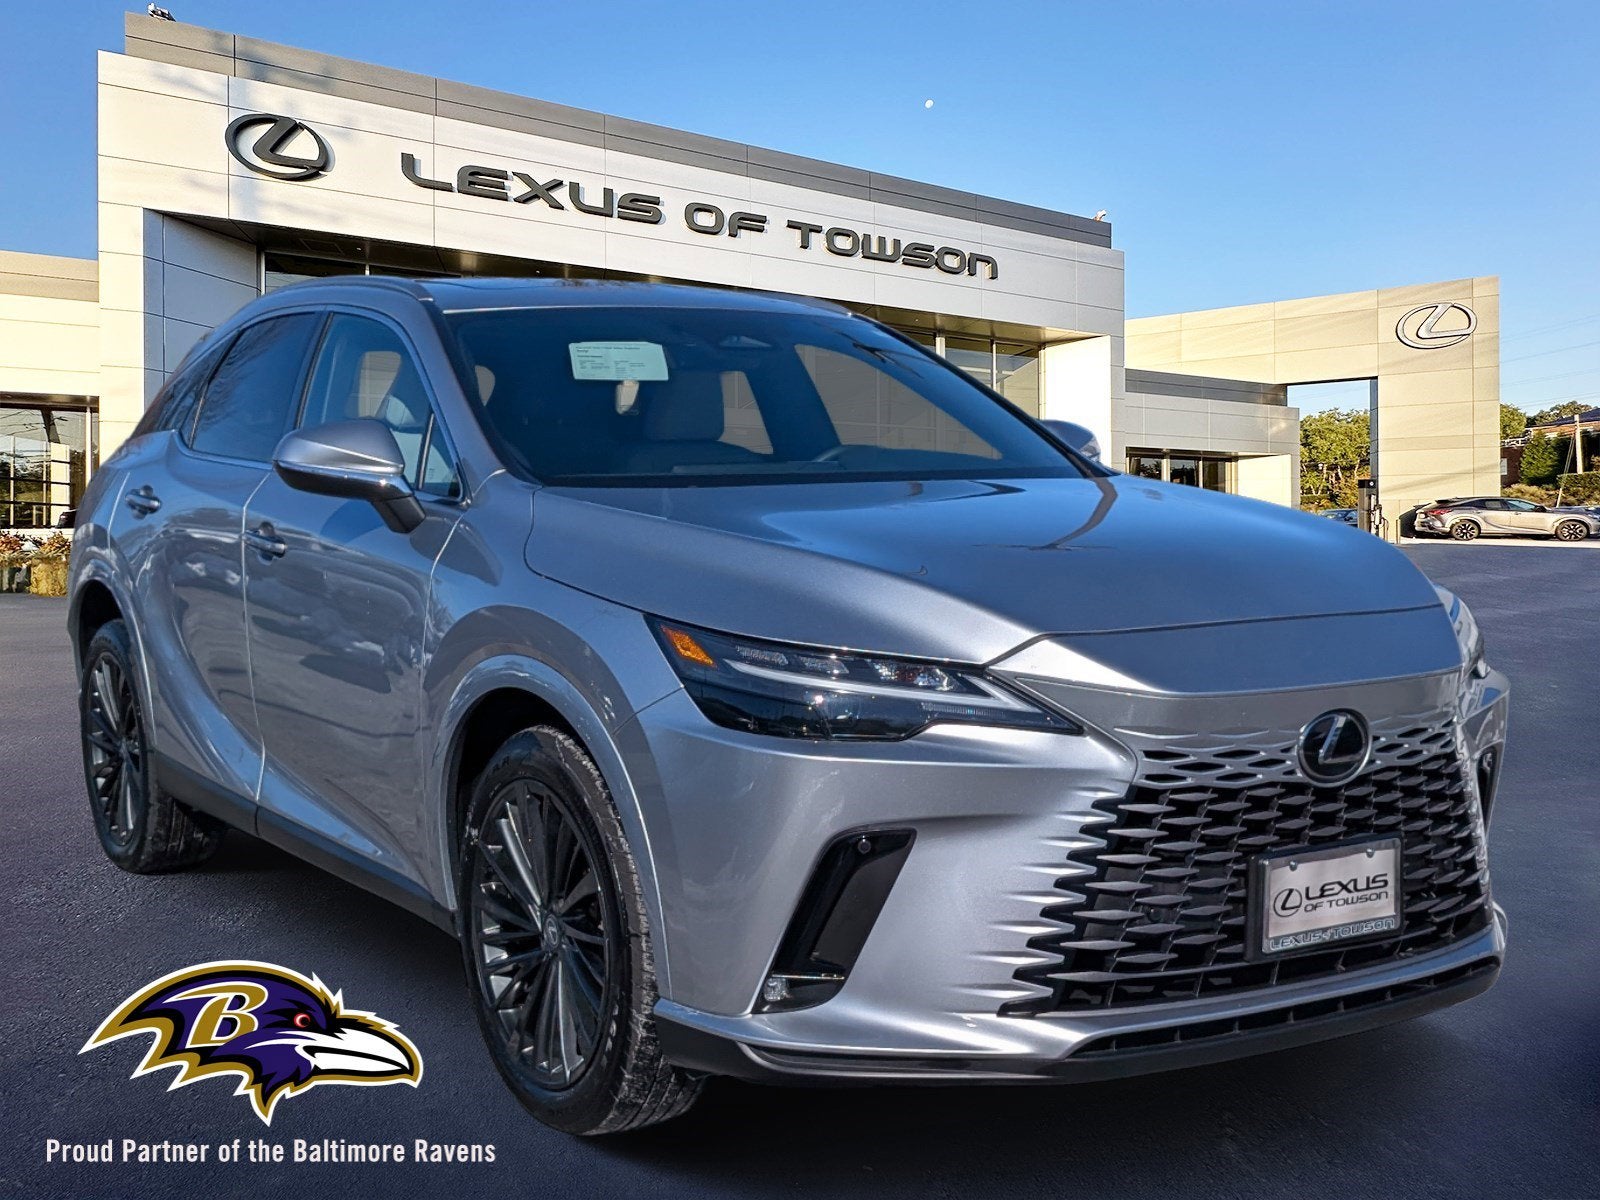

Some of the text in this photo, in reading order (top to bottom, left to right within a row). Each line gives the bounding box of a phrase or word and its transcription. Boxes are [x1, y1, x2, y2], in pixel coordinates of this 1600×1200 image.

[401, 152, 999, 279] LEXUS OF TOWSON
[1304, 891, 1389, 913] OF TOWSON
[1305, 873, 1389, 901] LEXUS
[1269, 931, 1322, 950] LEXUS
[1333, 918, 1395, 938] TOWSON
